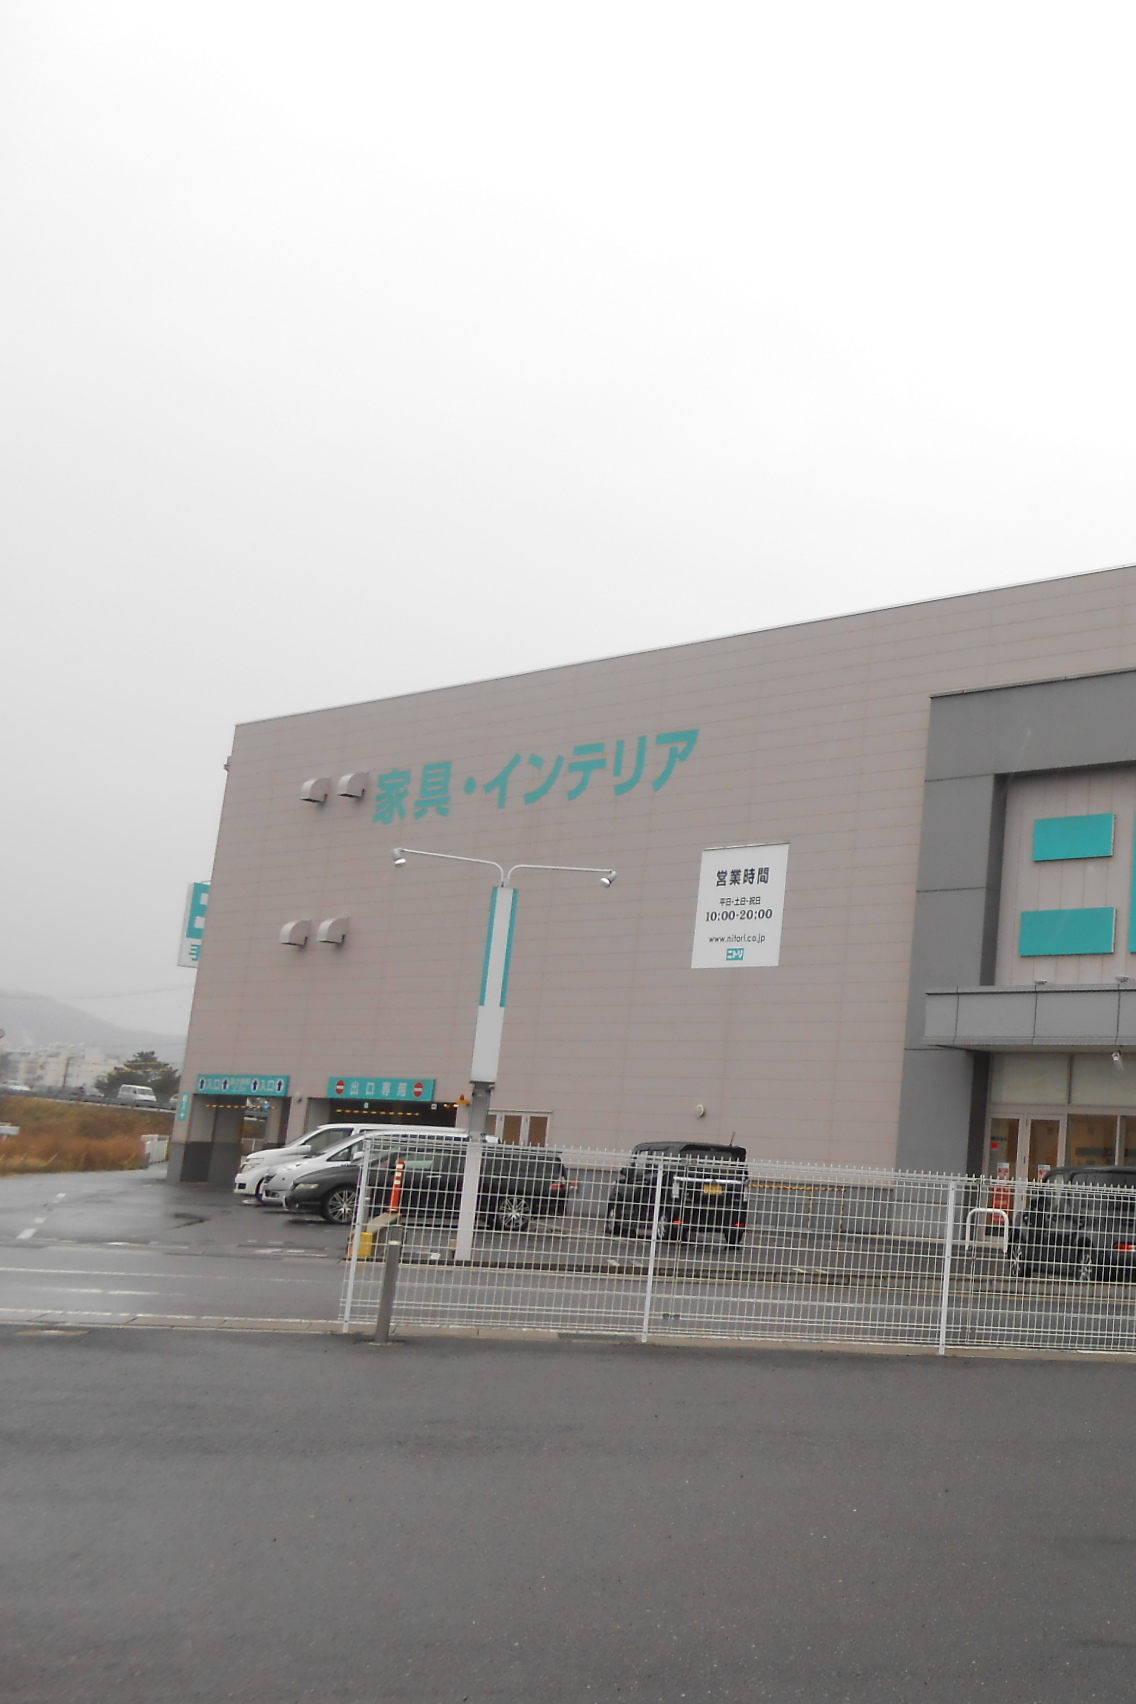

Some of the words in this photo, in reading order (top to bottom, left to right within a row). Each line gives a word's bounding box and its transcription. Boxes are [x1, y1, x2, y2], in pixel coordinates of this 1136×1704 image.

[373, 729, 700, 824] 家具・インテリア
[716, 867, 770, 887] 営業時間
[705, 908, 773, 922] 10:00-20:00
[708, 933, 766, 943] www.nitori.co.jp
[727, 949, 744, 959] ニトリ
